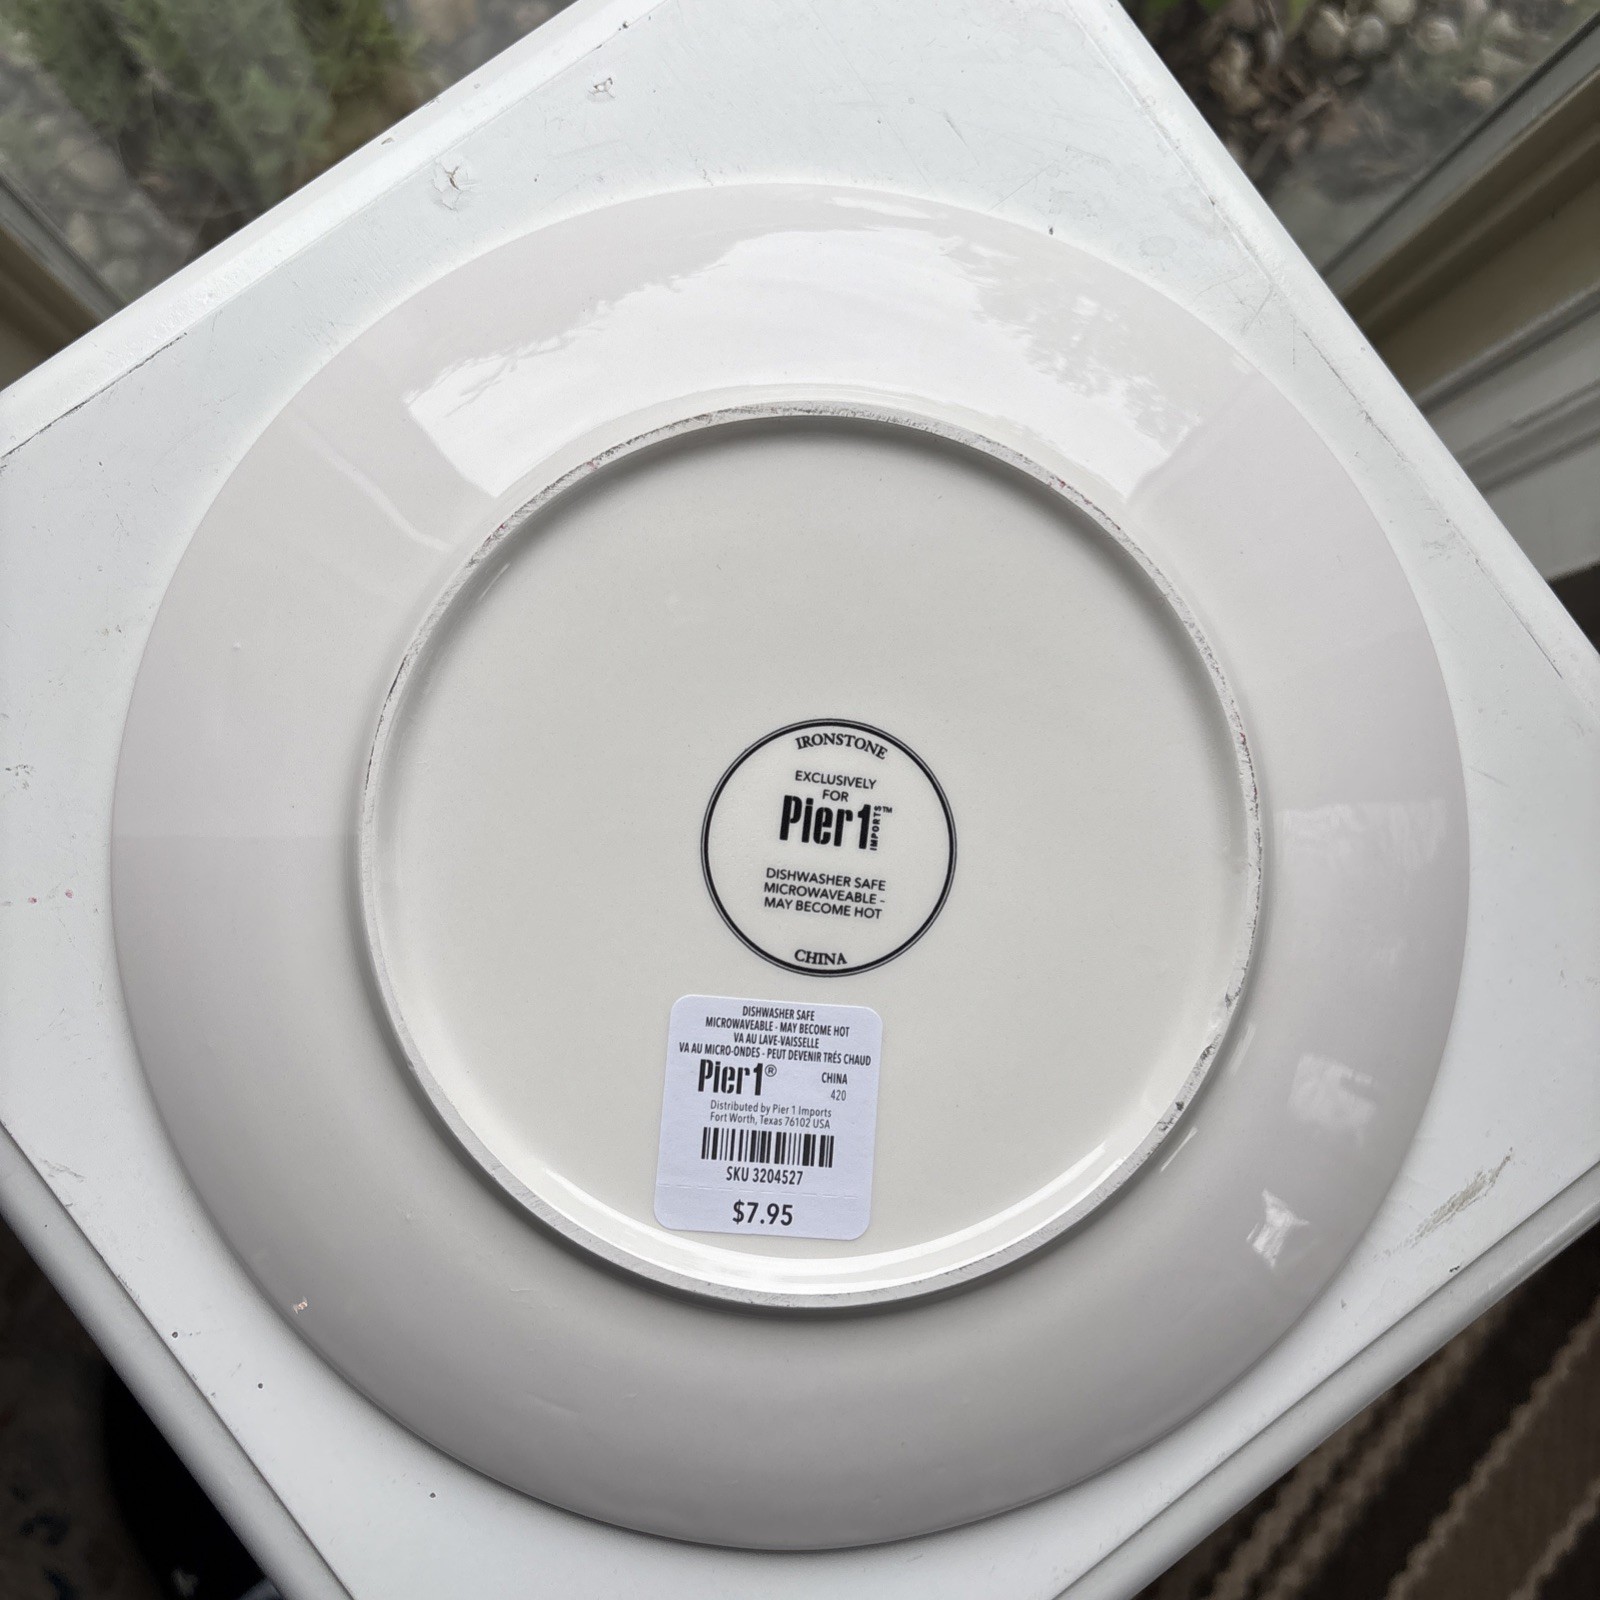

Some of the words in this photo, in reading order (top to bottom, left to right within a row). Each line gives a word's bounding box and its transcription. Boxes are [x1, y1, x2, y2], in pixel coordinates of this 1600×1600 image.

[795, 733, 888, 760] IRONSTONE
[795, 770, 877, 789] EXCLUSIVELY
[822, 790, 848, 802] FOR
[780, 794, 853, 847] Pier
[870, 805, 882, 851] IMPORTS
[766, 868, 851, 887] DISHWASHER
[854, 877, 886, 891] SAFE
[764, 882, 877, 904] MICROWAVEABLE
[764, 897, 793, 910] MAY
[795, 899, 851, 916] BECOME
[854, 906, 882, 919] HOT
[795, 949, 847, 966] CHINA
[742, 1006, 795, 1020] DISHWASHER
[796, 1010, 815, 1021] SAFE
[706, 1017, 774, 1031] MICROWAVEABLE
[780, 1022, 797, 1033] MAY
[799, 1024, 832, 1036] BECOME
[833, 1026, 849, 1037] HOT
[734, 1033, 744, 1044] VA
[746, 1033, 757, 1044] AU
[759, 1034, 819, 1048] LAVE-VAISSELLE
[679, 1042, 690, 1053] VA
[691, 1043, 703, 1053] AU
[704, 1044, 760, 1058] MICRO-ONDES
[767, 1048, 786, 1059] PEUT
[788, 1051, 821, 1062] DEVENIR
[844, 1054, 871, 1065] CHAUD
[698, 1059, 750, 1095] Pier
[821, 1072, 848, 1085] CHINA
[831, 1089, 846, 1101] 420
[710, 1100, 758, 1113] Distributed
[761, 1103, 770, 1115] by
[772, 1103, 789, 1114] Pier
[798, 1105, 831, 1118] Imports
[710, 1112, 728, 1122] Fort
[729, 1113, 757, 1125] Worth,
[760, 1115, 783, 1126] Texas
[785, 1116, 810, 1127] 76102
[813, 1119, 830, 1129] USA
[726, 1166, 749, 1182] SKU
[753, 1168, 803, 1185] 3204527
[733, 1199, 793, 1226] $7.95
